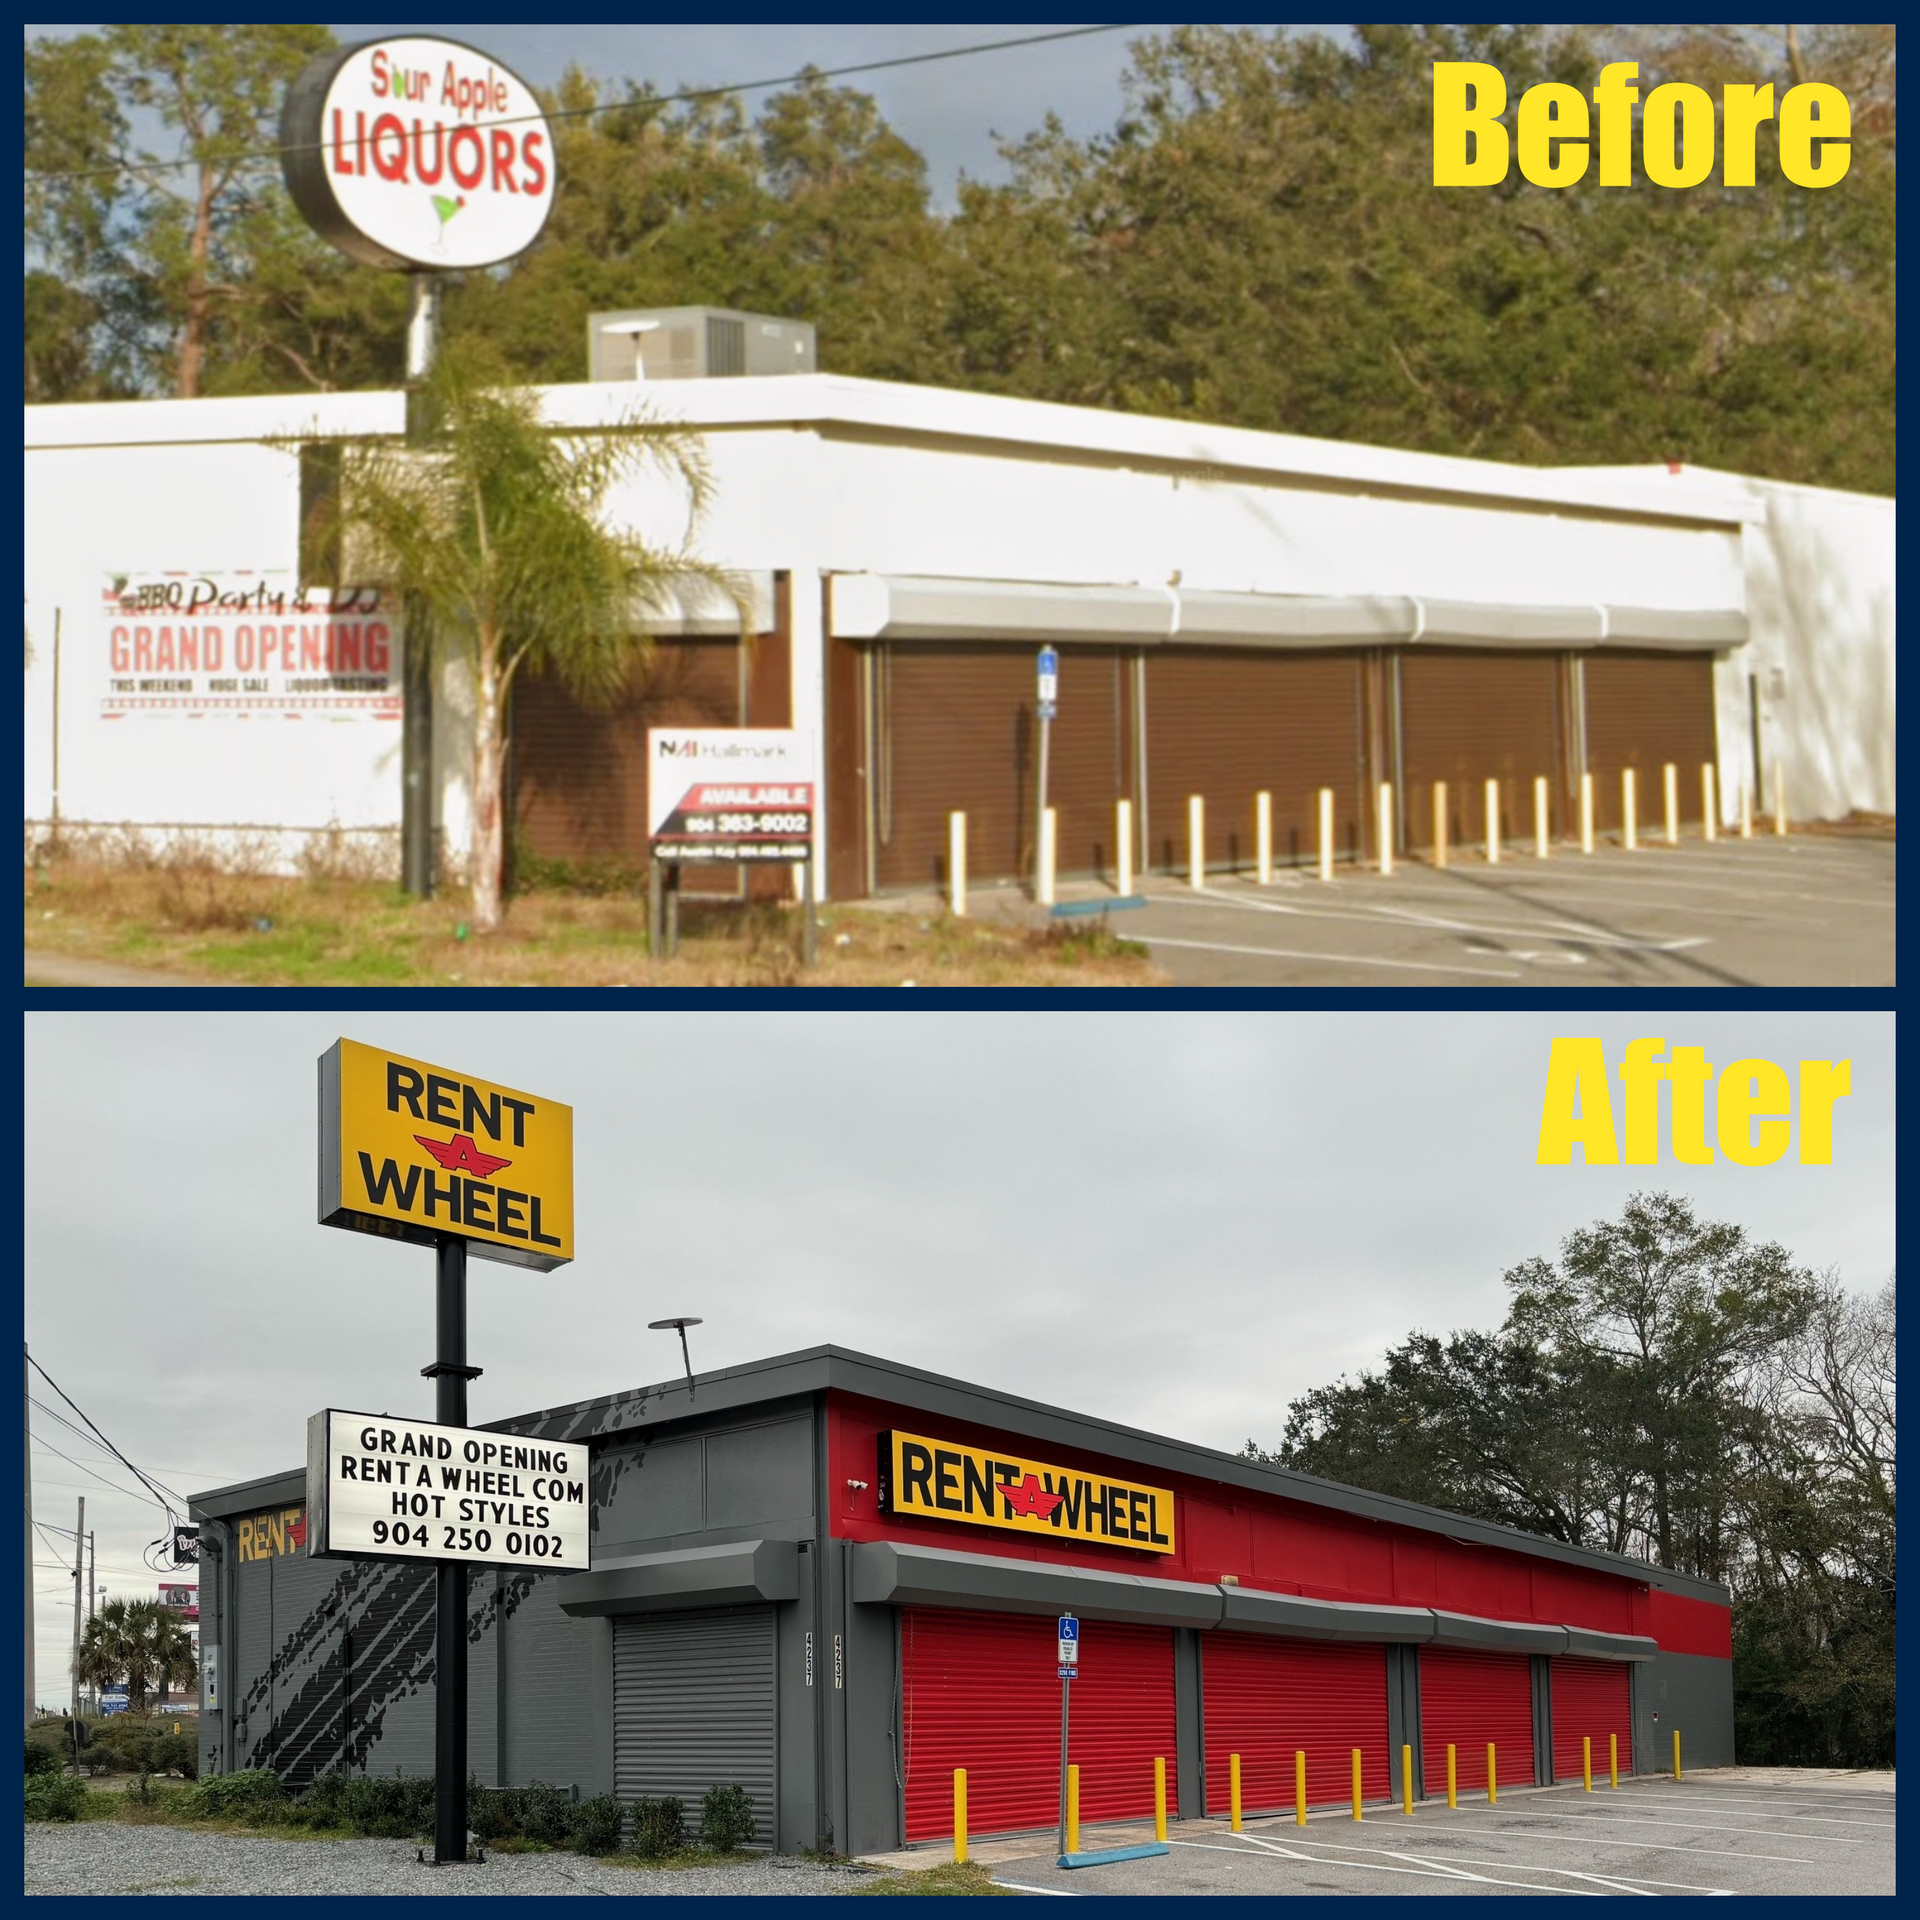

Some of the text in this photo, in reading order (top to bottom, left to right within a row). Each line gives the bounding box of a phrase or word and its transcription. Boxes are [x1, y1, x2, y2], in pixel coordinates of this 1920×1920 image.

[441, 60, 508, 119] Apple
[332, 107, 547, 197] LIQUORS
[136, 582, 183, 610] BBQ
[188, 578, 285, 616] Party
[110, 622, 391, 673] GRAND OPENING
[110, 678, 136, 693] THIS
[139, 678, 194, 693] WEEKEND
[208, 678, 239, 693] HUGE
[242, 678, 269, 693] SALE
[699, 786, 809, 805] AVAILABLE
[387, 1060, 536, 1148] RENT
[357, 1150, 562, 1249] WHEEL
[360, 1426, 568, 1474] GRAND OPENING
[341, 1455, 584, 1504] RENT A WHEEL COM
[901, 1440, 1020, 1520] RENT
[1043, 1472, 1169, 1545] WHEEL
[392, 1491, 550, 1529] HOT STYLES
[239, 1508, 301, 1563] RENT
[372, 1520, 563, 1559] 904 250 0102
